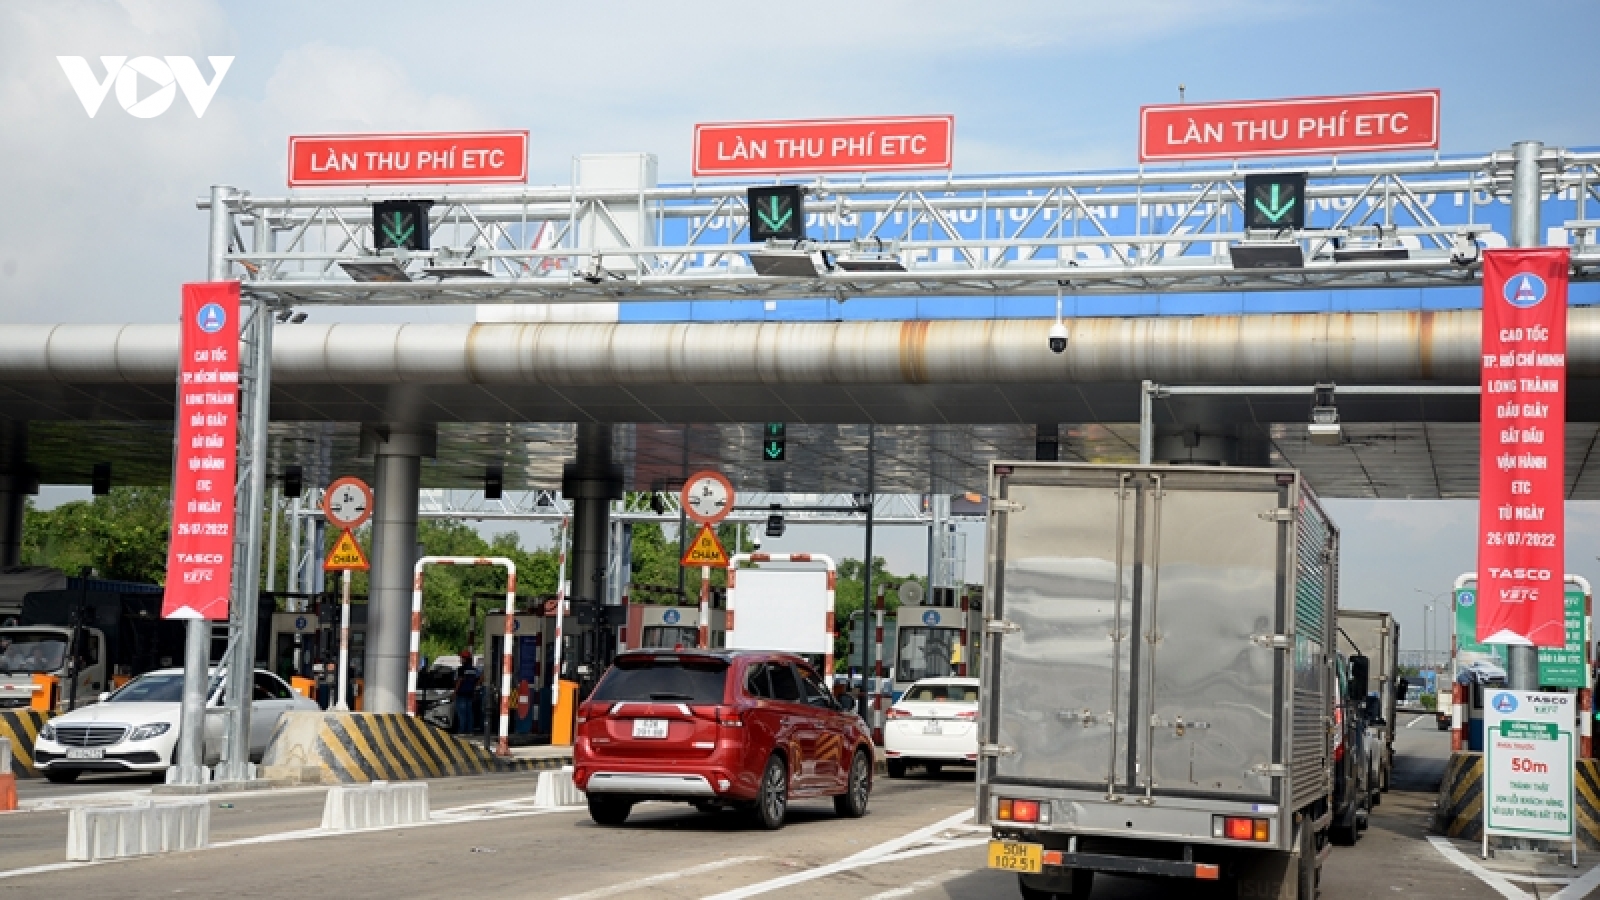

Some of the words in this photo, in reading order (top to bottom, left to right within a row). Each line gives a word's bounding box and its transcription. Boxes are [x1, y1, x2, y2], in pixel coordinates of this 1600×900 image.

[1167, 118, 1224, 145] LÀN
[1232, 119, 1288, 142] THU
[1297, 111, 1349, 139] PHÍ
[1355, 113, 1409, 137] ETC
[717, 136, 767, 161] LÀN
[775, 137, 824, 159] THU
[832, 132, 875, 157] PHÍ
[880, 135, 927, 155] ETC
[310, 148, 358, 173] LÀN
[364, 150, 410, 171] THU
[417, 146, 457, 170] PHÍ
[463, 149, 505, 169] ETC
[1499, 327, 1523, 342] CAO
[1526, 324, 1549, 342] TỐC
[194, 349, 209, 363] CAO
[1482, 353, 1498, 368] TP.
[1516, 350, 1536, 367] CHÍ
[1536, 353, 1565, 367] MINH
[219, 371, 239, 383] MINH
[1487, 380, 1516, 394] LONG
[1520, 376, 1559, 393] THÀNH
[185, 393, 205, 405] LONG
[1517, 452, 1548, 469] HÀNH
[195, 480, 212, 492] ETC
[1511, 480, 1532, 494] ETC
[1515, 503, 1545, 521] NGÀY
[177, 523, 229, 535] 26/07/2022
[1486, 531, 1557, 547] 26/07/2022
[176, 553, 224, 564] TASCO
[1487, 567, 1552, 580] TASCO
[1499, 585, 1539, 603] VETC
[1526, 695, 1568, 705] TASCO
[1511, 757, 1548, 774] 50m
[1004, 843, 1027, 856] 50H
